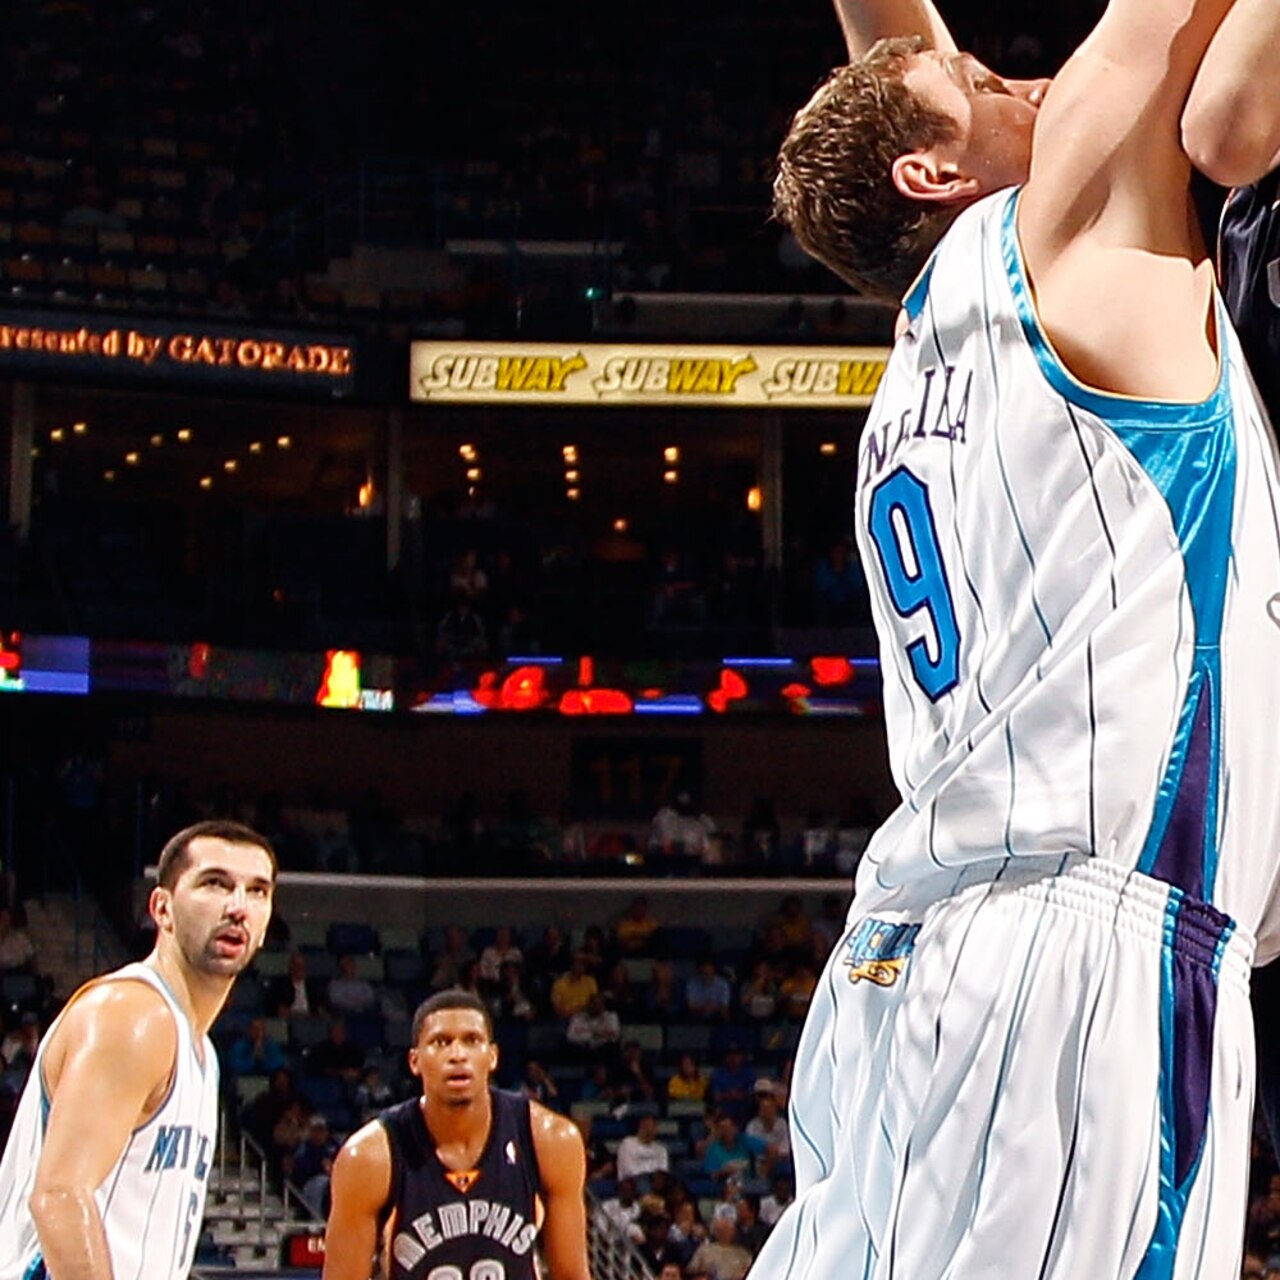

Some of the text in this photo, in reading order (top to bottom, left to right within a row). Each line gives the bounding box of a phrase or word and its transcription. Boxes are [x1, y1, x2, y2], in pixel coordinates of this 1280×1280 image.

[127, 330, 160, 365] by
[168, 335, 350, 375] GATORADE
[419, 351, 588, 398] SUBWAY
[592, 353, 759, 399] SUBWAY
[868, 464, 962, 704] 9
[394, 1200, 537, 1270] MEMPHIS
